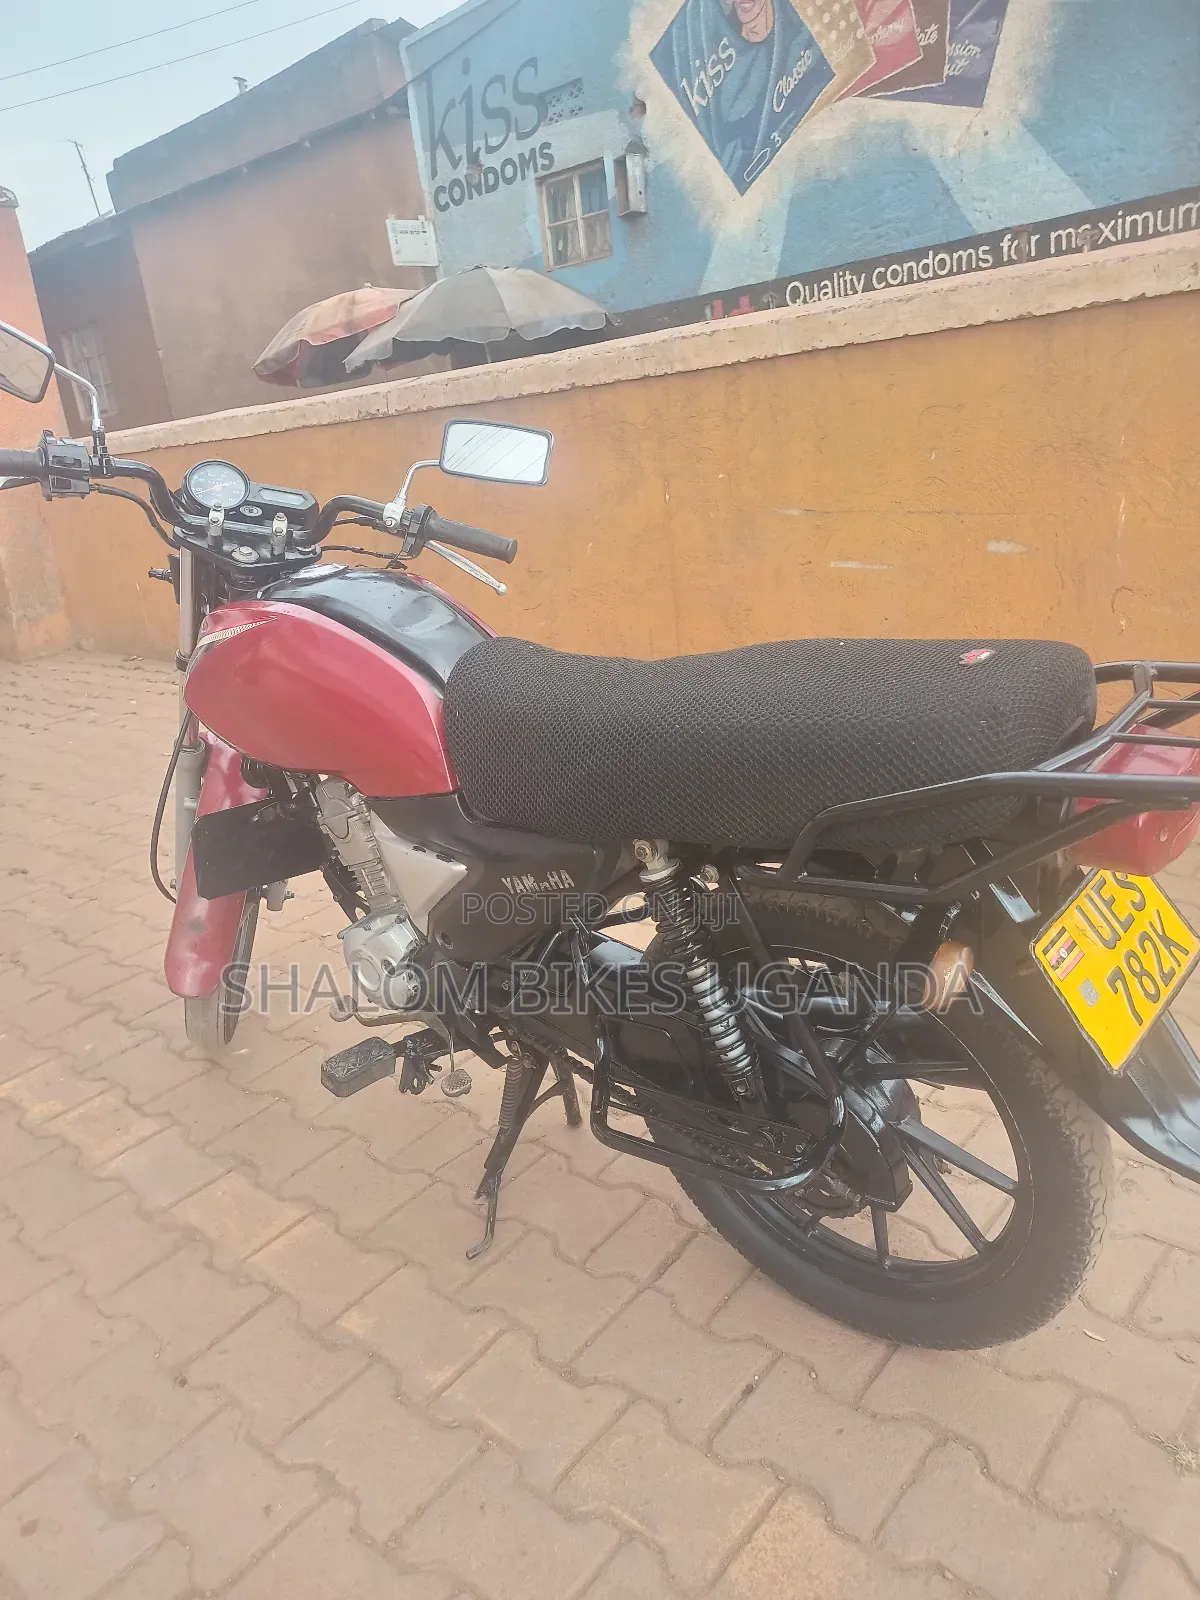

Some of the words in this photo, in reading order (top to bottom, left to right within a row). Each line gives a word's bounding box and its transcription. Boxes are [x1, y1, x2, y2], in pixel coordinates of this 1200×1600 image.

[773, 49, 813, 113] Classic
[433, 142, 555, 212] CONDOMS
[785, 271, 866, 307] Quality
[872, 243, 993, 289] condoms
[1076, 870, 1147, 950] UES
[1106, 909, 1190, 1027] 782K
